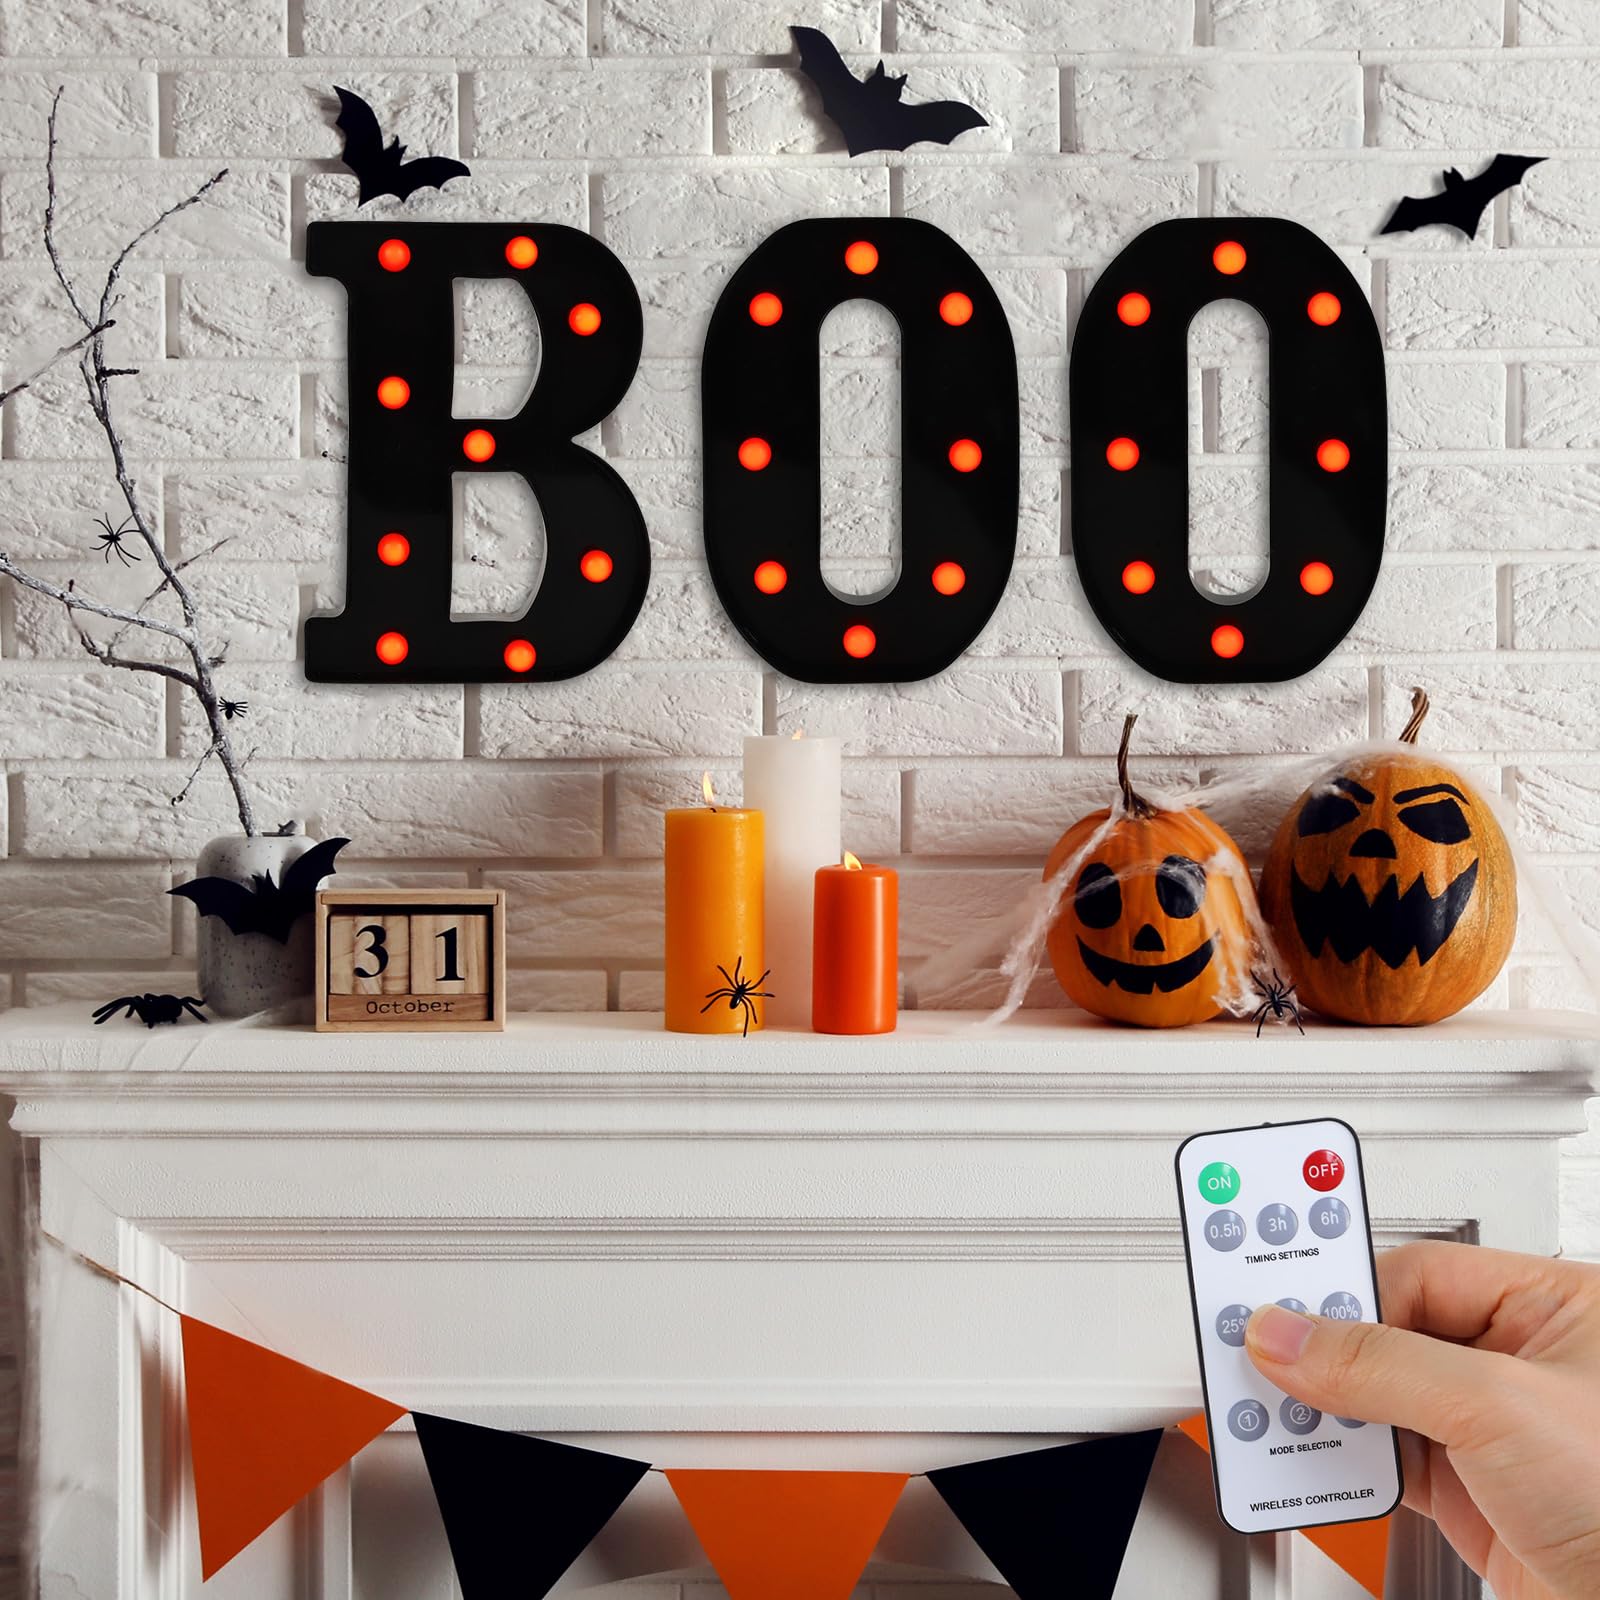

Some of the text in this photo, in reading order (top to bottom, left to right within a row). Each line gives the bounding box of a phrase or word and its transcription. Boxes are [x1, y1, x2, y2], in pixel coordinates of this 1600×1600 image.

[305, 217, 1388, 683] BOO
[366, 1000, 456, 1014] October
[1308, 1163, 1339, 1179] OFF
[1207, 1176, 1232, 1190] ON
[1268, 1217, 1287, 1232] 3h
[1320, 1211, 1339, 1226] 6h
[1210, 1223, 1241, 1239] 0.5h
[1245, 1248, 1319, 1264] TIMING SETTINGS
[1324, 1304, 1359, 1319] 100%
[1270, 1440, 1342, 1456] MODE SELECTION
[1250, 1488, 1375, 1512] WIRELESS CONTROLLER
